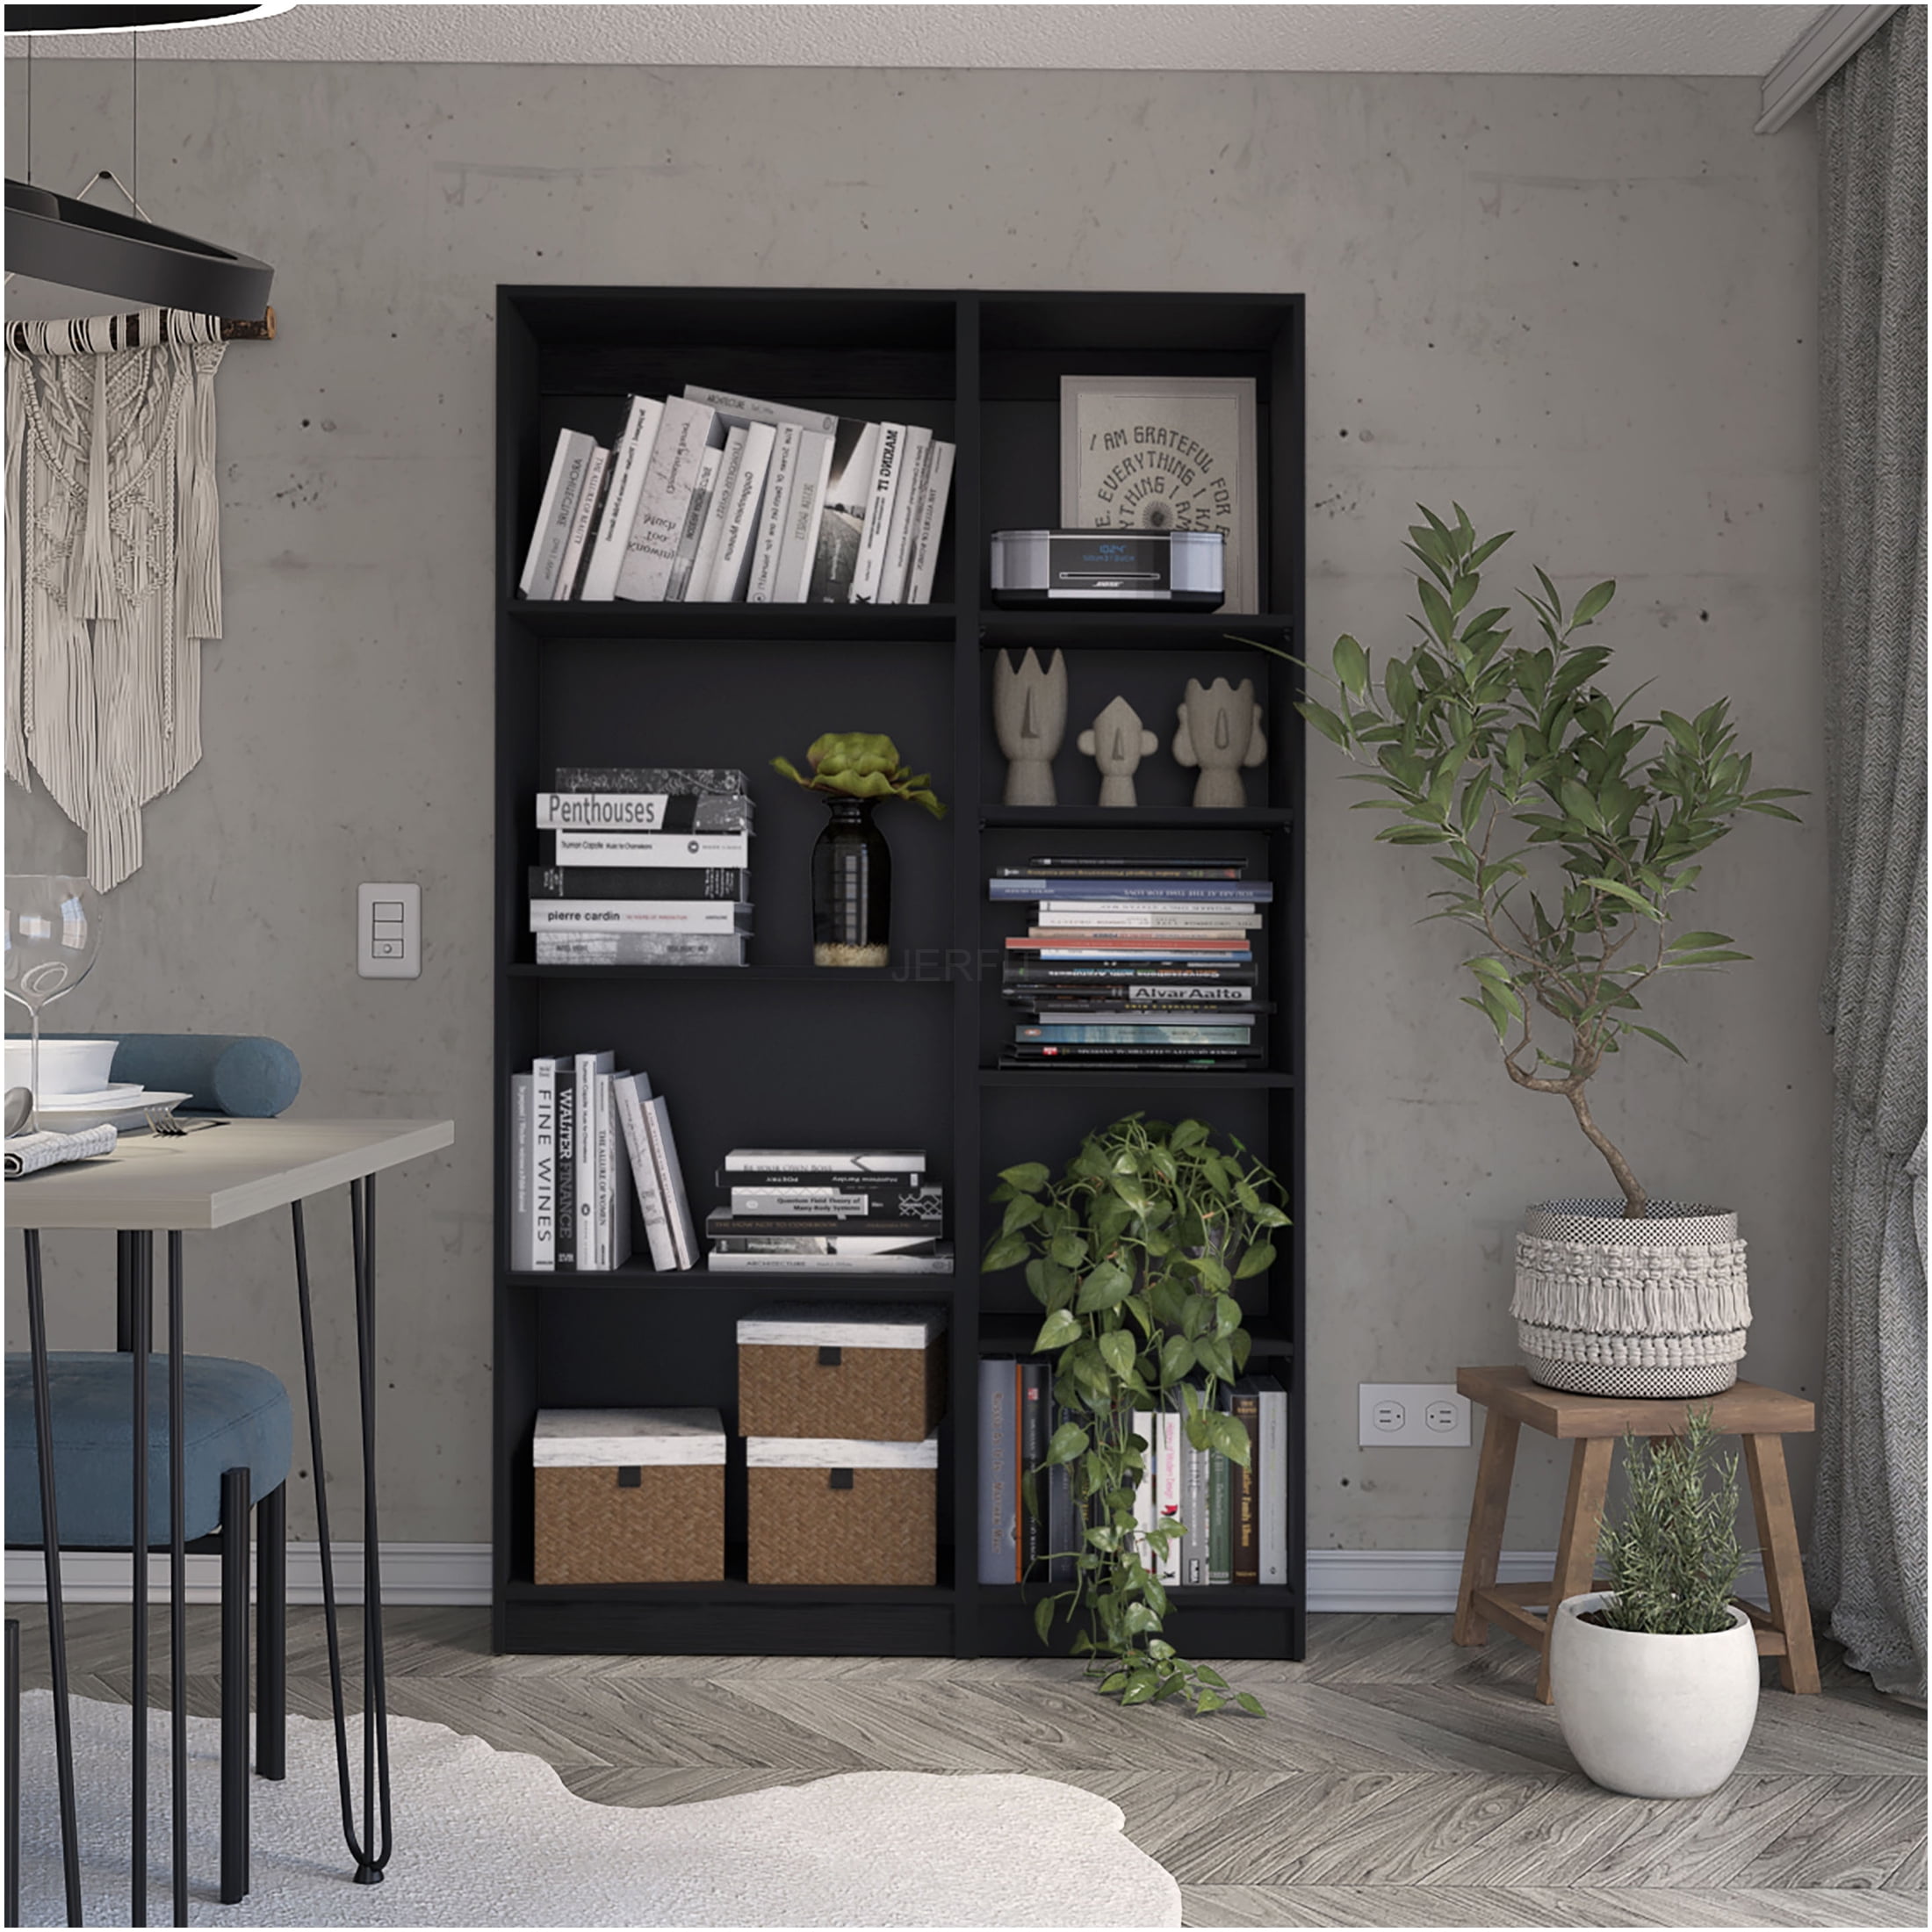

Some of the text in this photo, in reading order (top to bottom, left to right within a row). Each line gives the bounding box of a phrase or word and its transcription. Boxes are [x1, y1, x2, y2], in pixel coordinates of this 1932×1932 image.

[1097, 450, 1196, 503] EVERYTHING
[1103, 428, 1128, 451] AM
[1133, 425, 1214, 475] GRATEFUL
[1208, 476, 1231, 516] FOR
[549, 795, 655, 825] Penthouses
[548, 910, 581, 922] pierre
[584, 910, 621, 921] cardin
[559, 1088, 573, 1159] WALTER
[537, 1090, 551, 1243] FINE WINES
[598, 1148, 607, 1180] ALLURE
[559, 1162, 573, 1239] FINANCE
[598, 1193, 607, 1226] WOMEN
